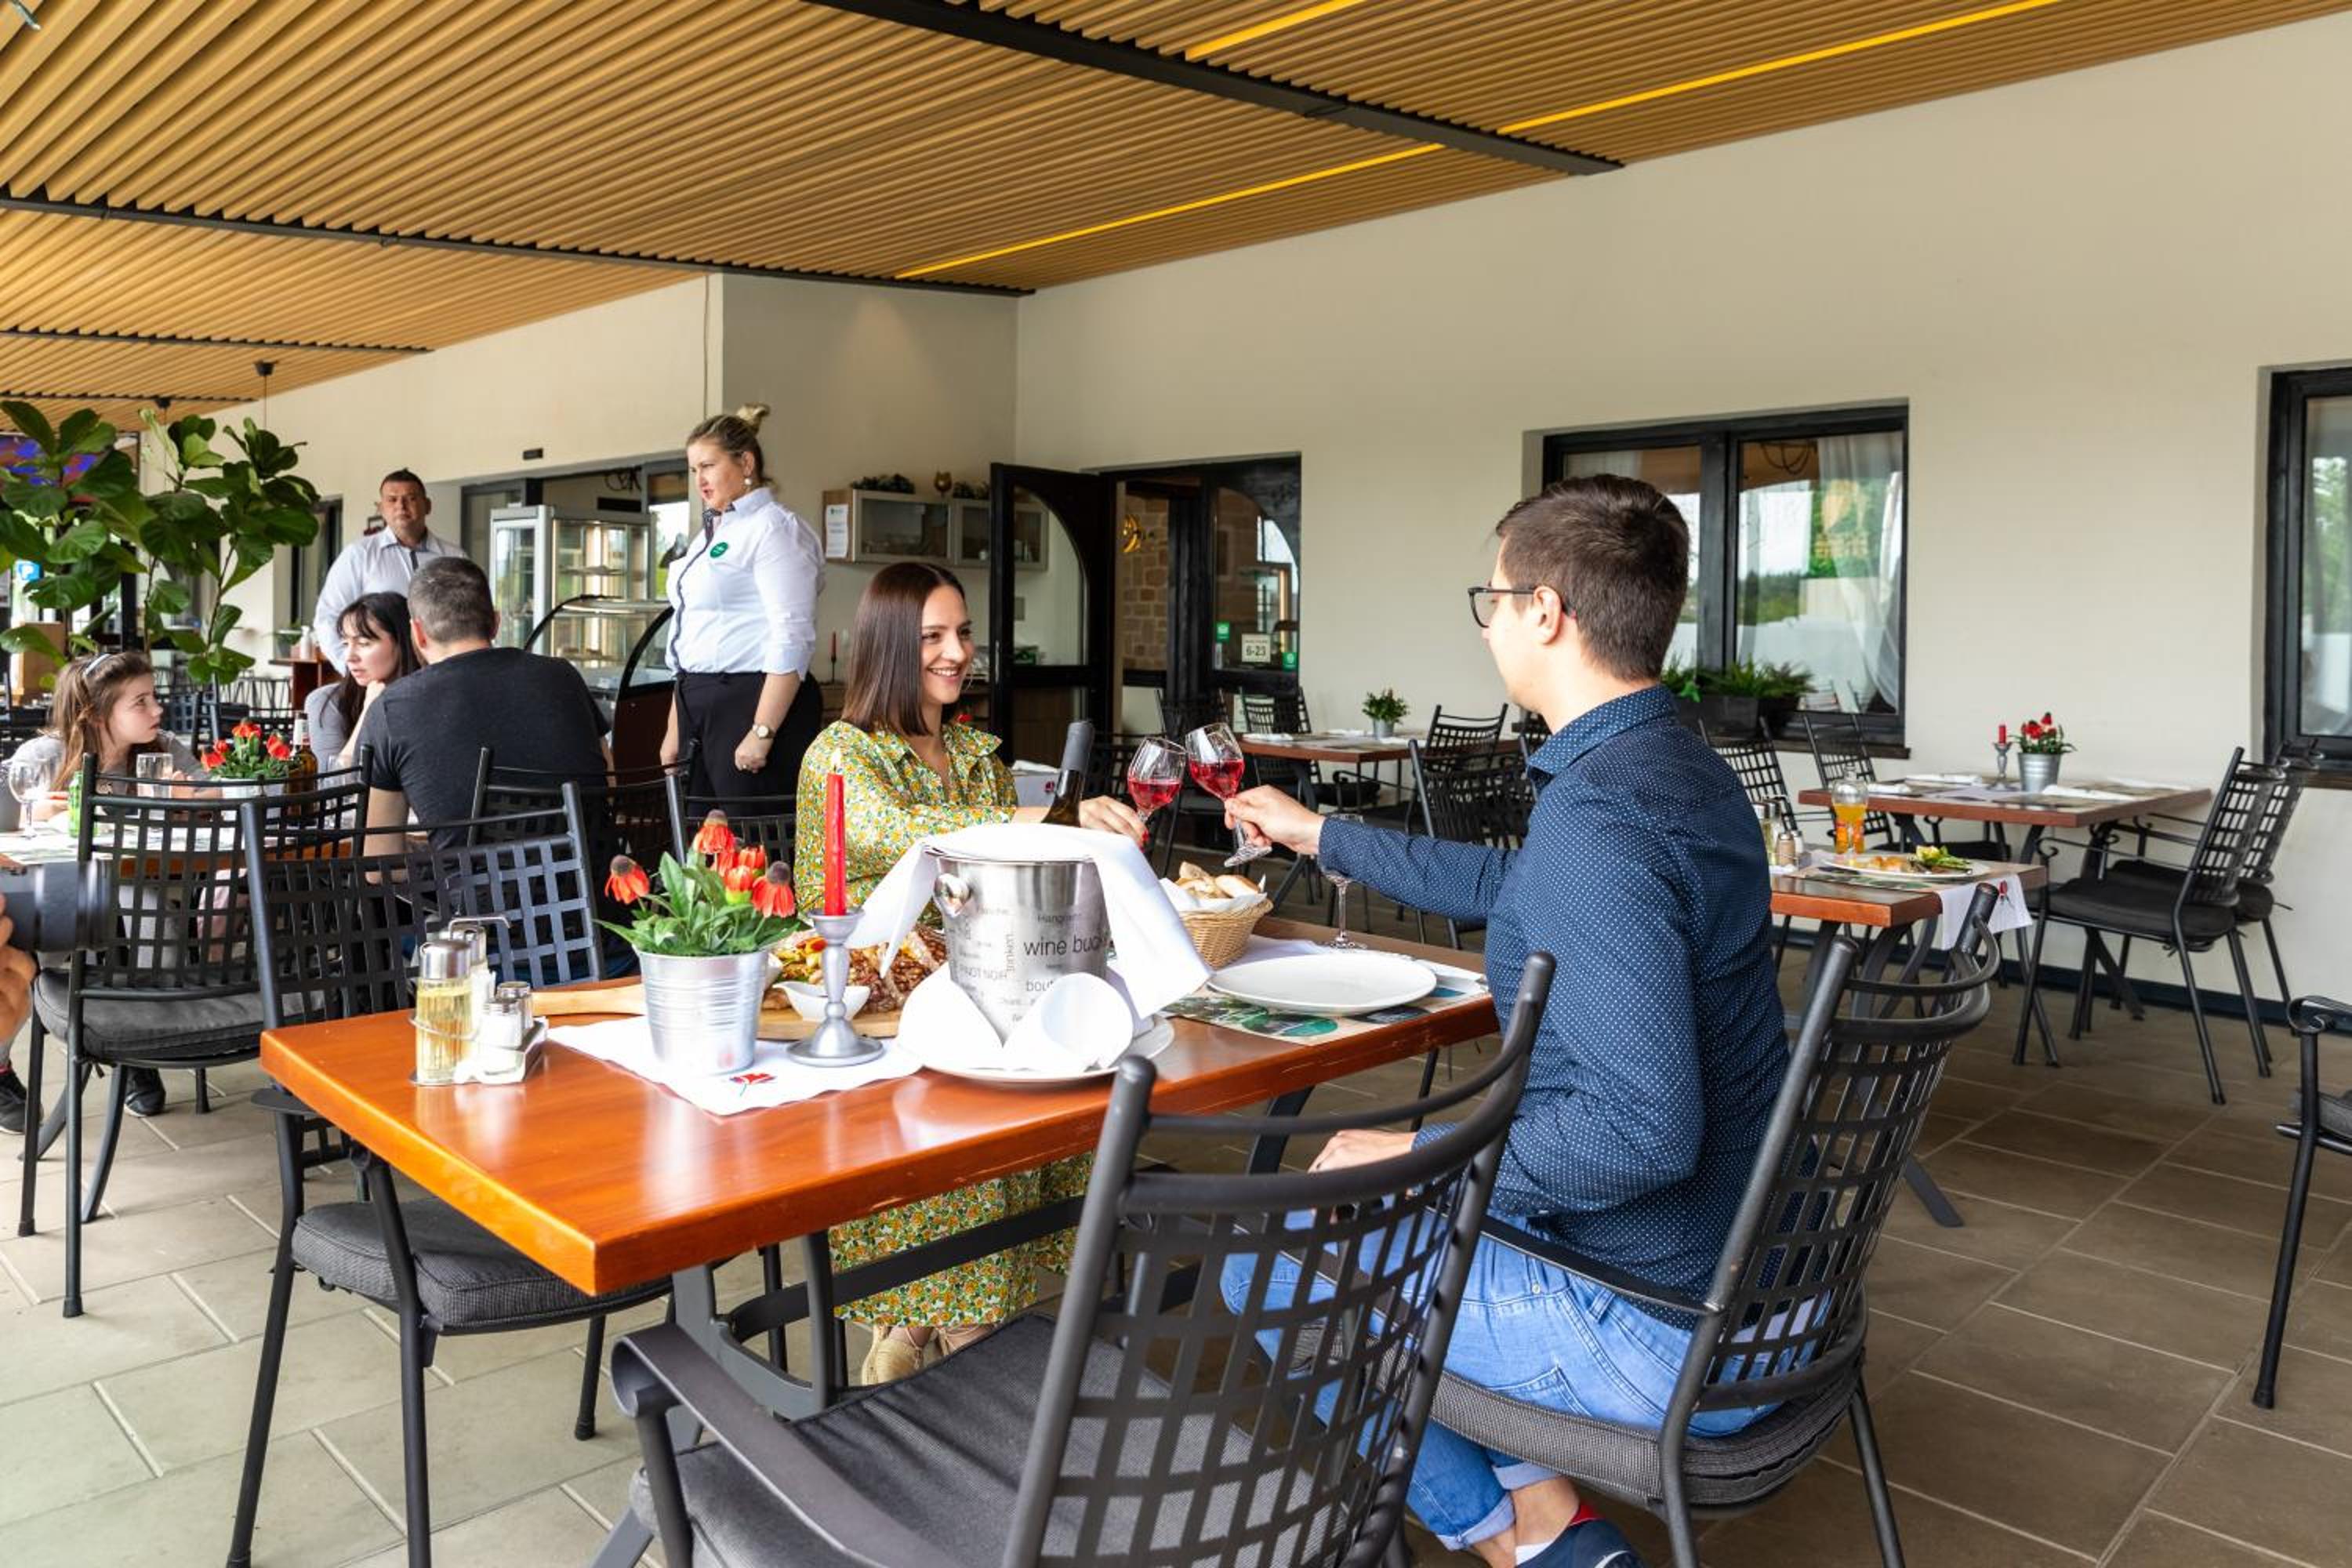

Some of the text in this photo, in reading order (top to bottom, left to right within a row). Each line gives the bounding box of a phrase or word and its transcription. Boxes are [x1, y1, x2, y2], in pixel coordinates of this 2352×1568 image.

[21, 565, 34, 580] P
[1023, 936, 1067, 956] wine
[1025, 978, 1054, 992] bou
